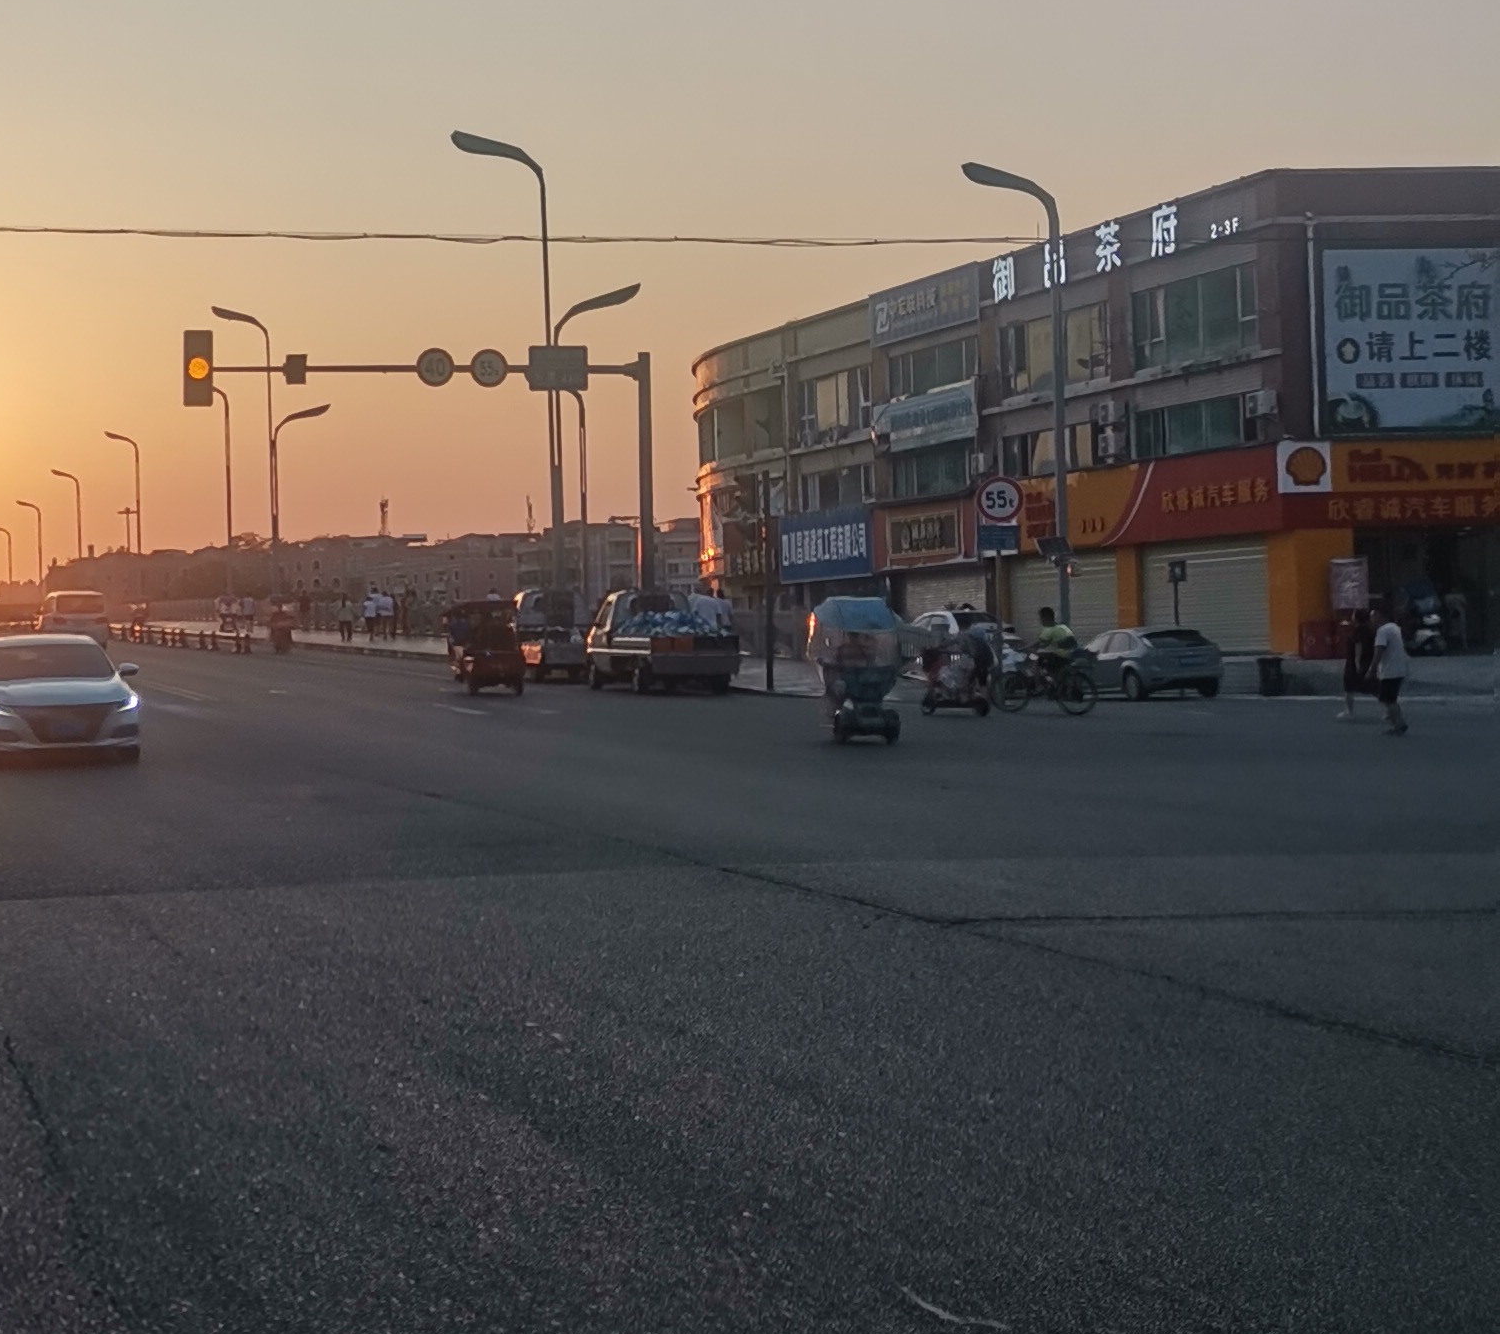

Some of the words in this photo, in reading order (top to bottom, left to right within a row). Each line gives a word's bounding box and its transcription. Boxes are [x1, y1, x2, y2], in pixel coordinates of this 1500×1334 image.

[991, 203, 1178, 304] 御品茶府
[1334, 282, 1492, 322] 御品茶府
[1365, 329, 1492, 363] 请上二楼
[423, 357, 446, 377] 40
[985, 489, 1015, 510] 55t
